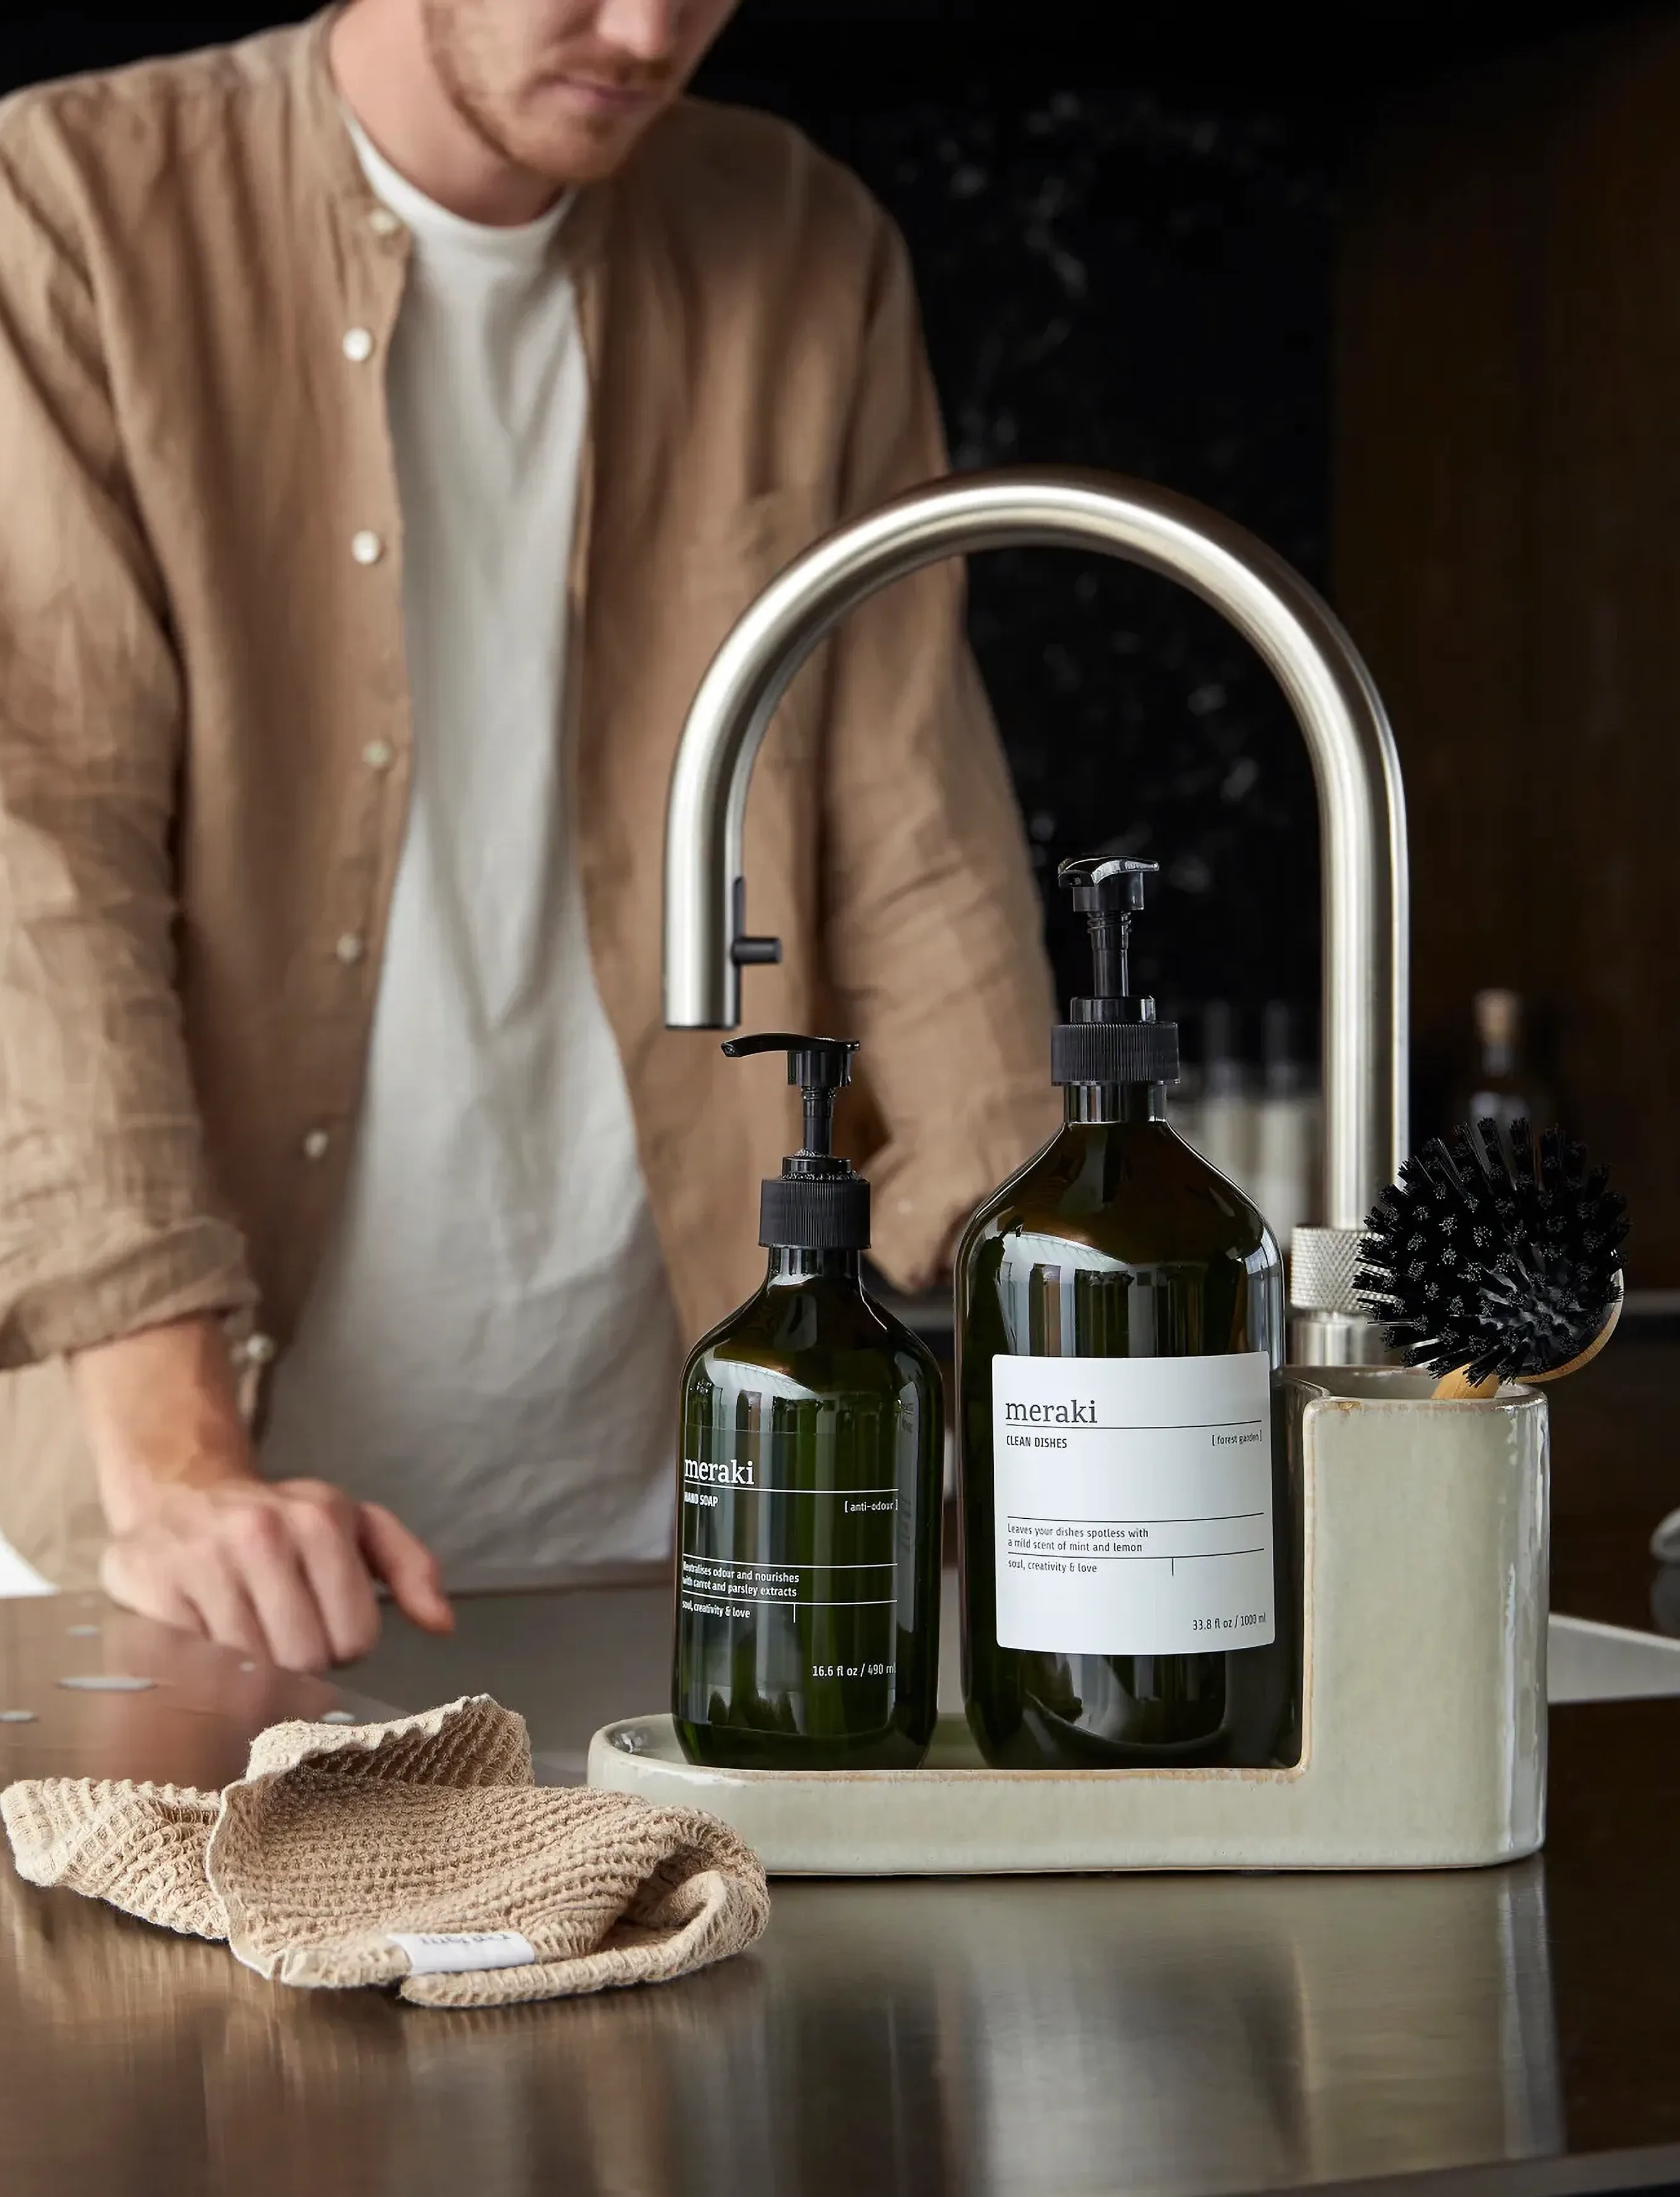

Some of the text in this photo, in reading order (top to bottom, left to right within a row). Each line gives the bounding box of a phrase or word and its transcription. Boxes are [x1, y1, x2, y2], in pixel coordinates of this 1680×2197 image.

[1006, 1399, 1098, 1424] meraki
[1006, 1435, 1068, 1449] CLEAN DISHES
[684, 1458, 755, 1485] meraki
[699, 1493, 719, 1508] SOAP
[1035, 1526, 1053, 1537] your
[1056, 1526, 1085, 1537] dishes
[1086, 1526, 1125, 1540] spotless
[1128, 1527, 1149, 1538] with
[1007, 1539, 1013, 1547] a
[1033, 1540, 1055, 1550] scent
[1057, 1540, 1067, 1550] of
[1070, 1542, 1090, 1552] mint
[1093, 1542, 1110, 1552] and
[1113, 1542, 1143, 1552] lemon
[1028, 1561, 1067, 1573] creativity
[1069, 1563, 1075, 1572] &
[1078, 1563, 1098, 1573] love
[712, 1567, 735, 1579] odour
[736, 1570, 753, 1581] and
[755, 1571, 800, 1584] nourishes
[712, 1581, 726, 1592] and
[727, 1583, 758, 1597] parsley
[760, 1586, 797, 1597] extracts
[732, 1606, 751, 1618] love
[1193, 1619, 1212, 1631] 33.8
[1223, 1619, 1232, 1629] oz
[812, 1665, 834, 1677] 16.6
[836, 1665, 844, 1677] fl
[846, 1667, 859, 1676] oz
[867, 1663, 884, 1676] 490
